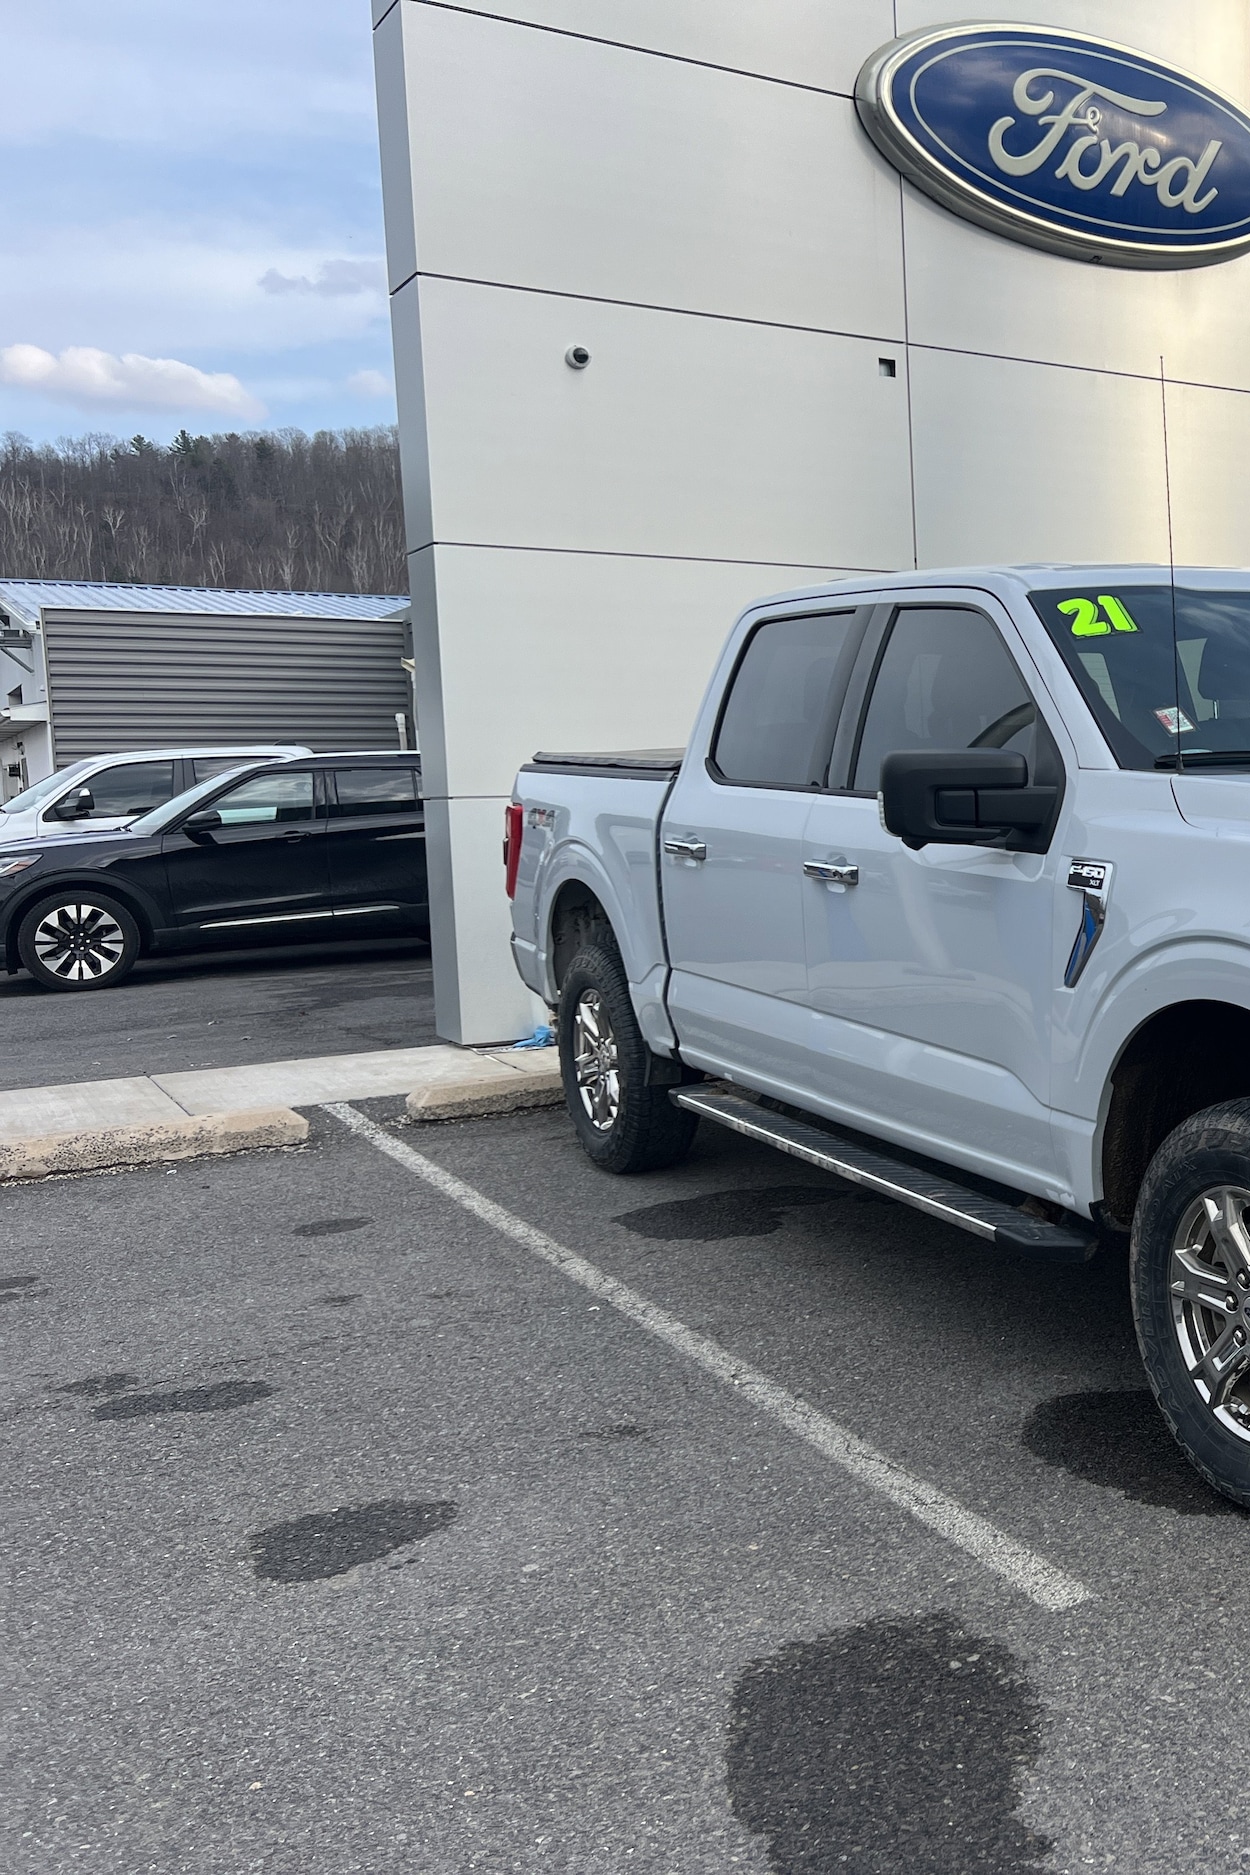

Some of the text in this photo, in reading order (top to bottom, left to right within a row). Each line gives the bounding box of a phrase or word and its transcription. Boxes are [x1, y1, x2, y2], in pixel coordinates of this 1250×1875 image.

[988, 68, 1223, 214] Ford
[1056, 594, 1140, 637] 21
[1069, 865, 1105, 879] F-150
[1089, 879, 1101, 887] XLT
